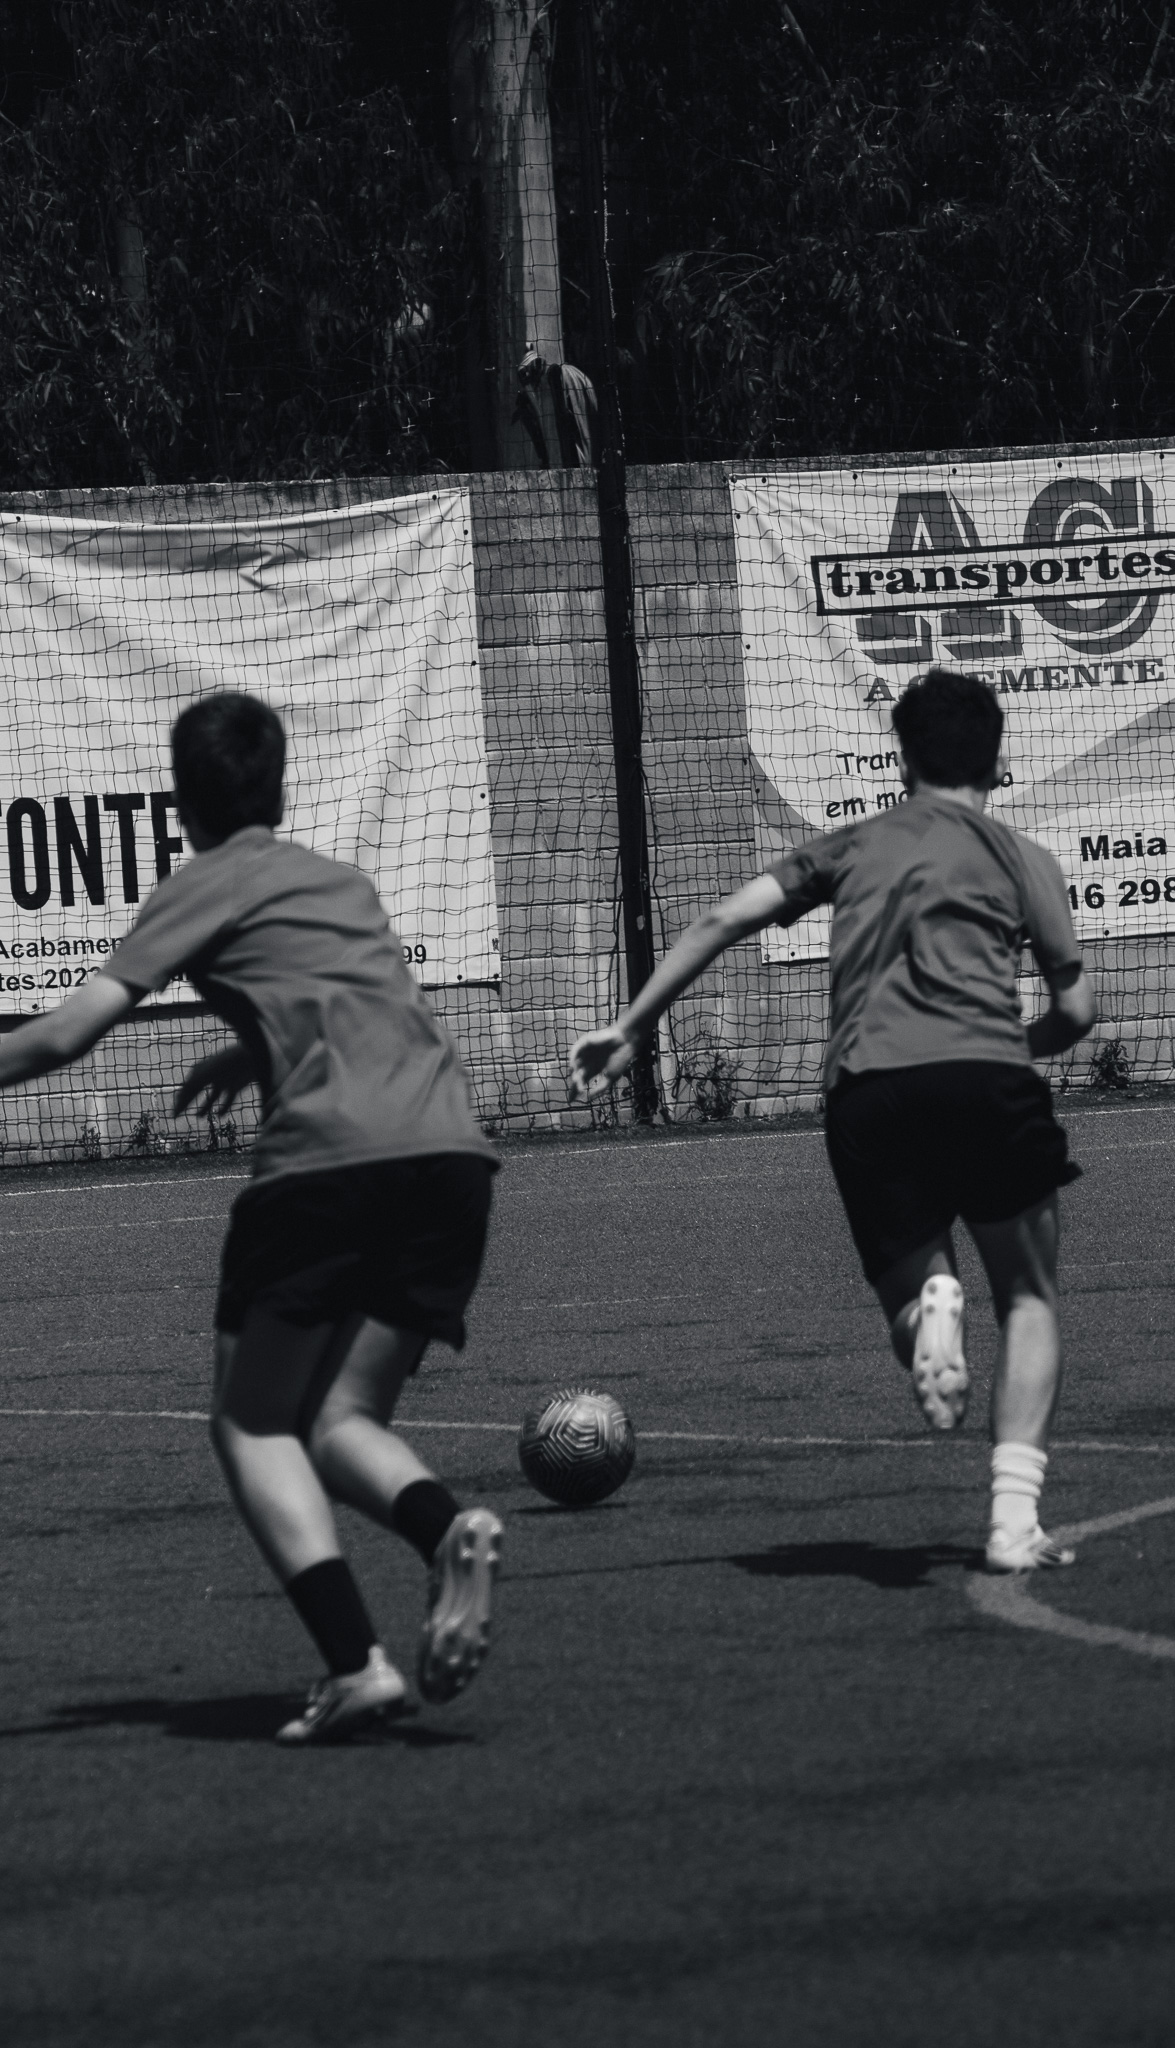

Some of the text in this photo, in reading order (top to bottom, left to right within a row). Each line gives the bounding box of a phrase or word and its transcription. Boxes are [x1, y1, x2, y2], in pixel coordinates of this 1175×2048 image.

[827, 545, 1175, 599] transportes
[836, 751, 898, 776] Tran
[826, 796, 865, 818] em
[0, 791, 184, 910] ONTE
[1081, 832, 1167, 862] Maia
[1068, 883, 1105, 910] 16
[401, 944, 427, 965] 99
